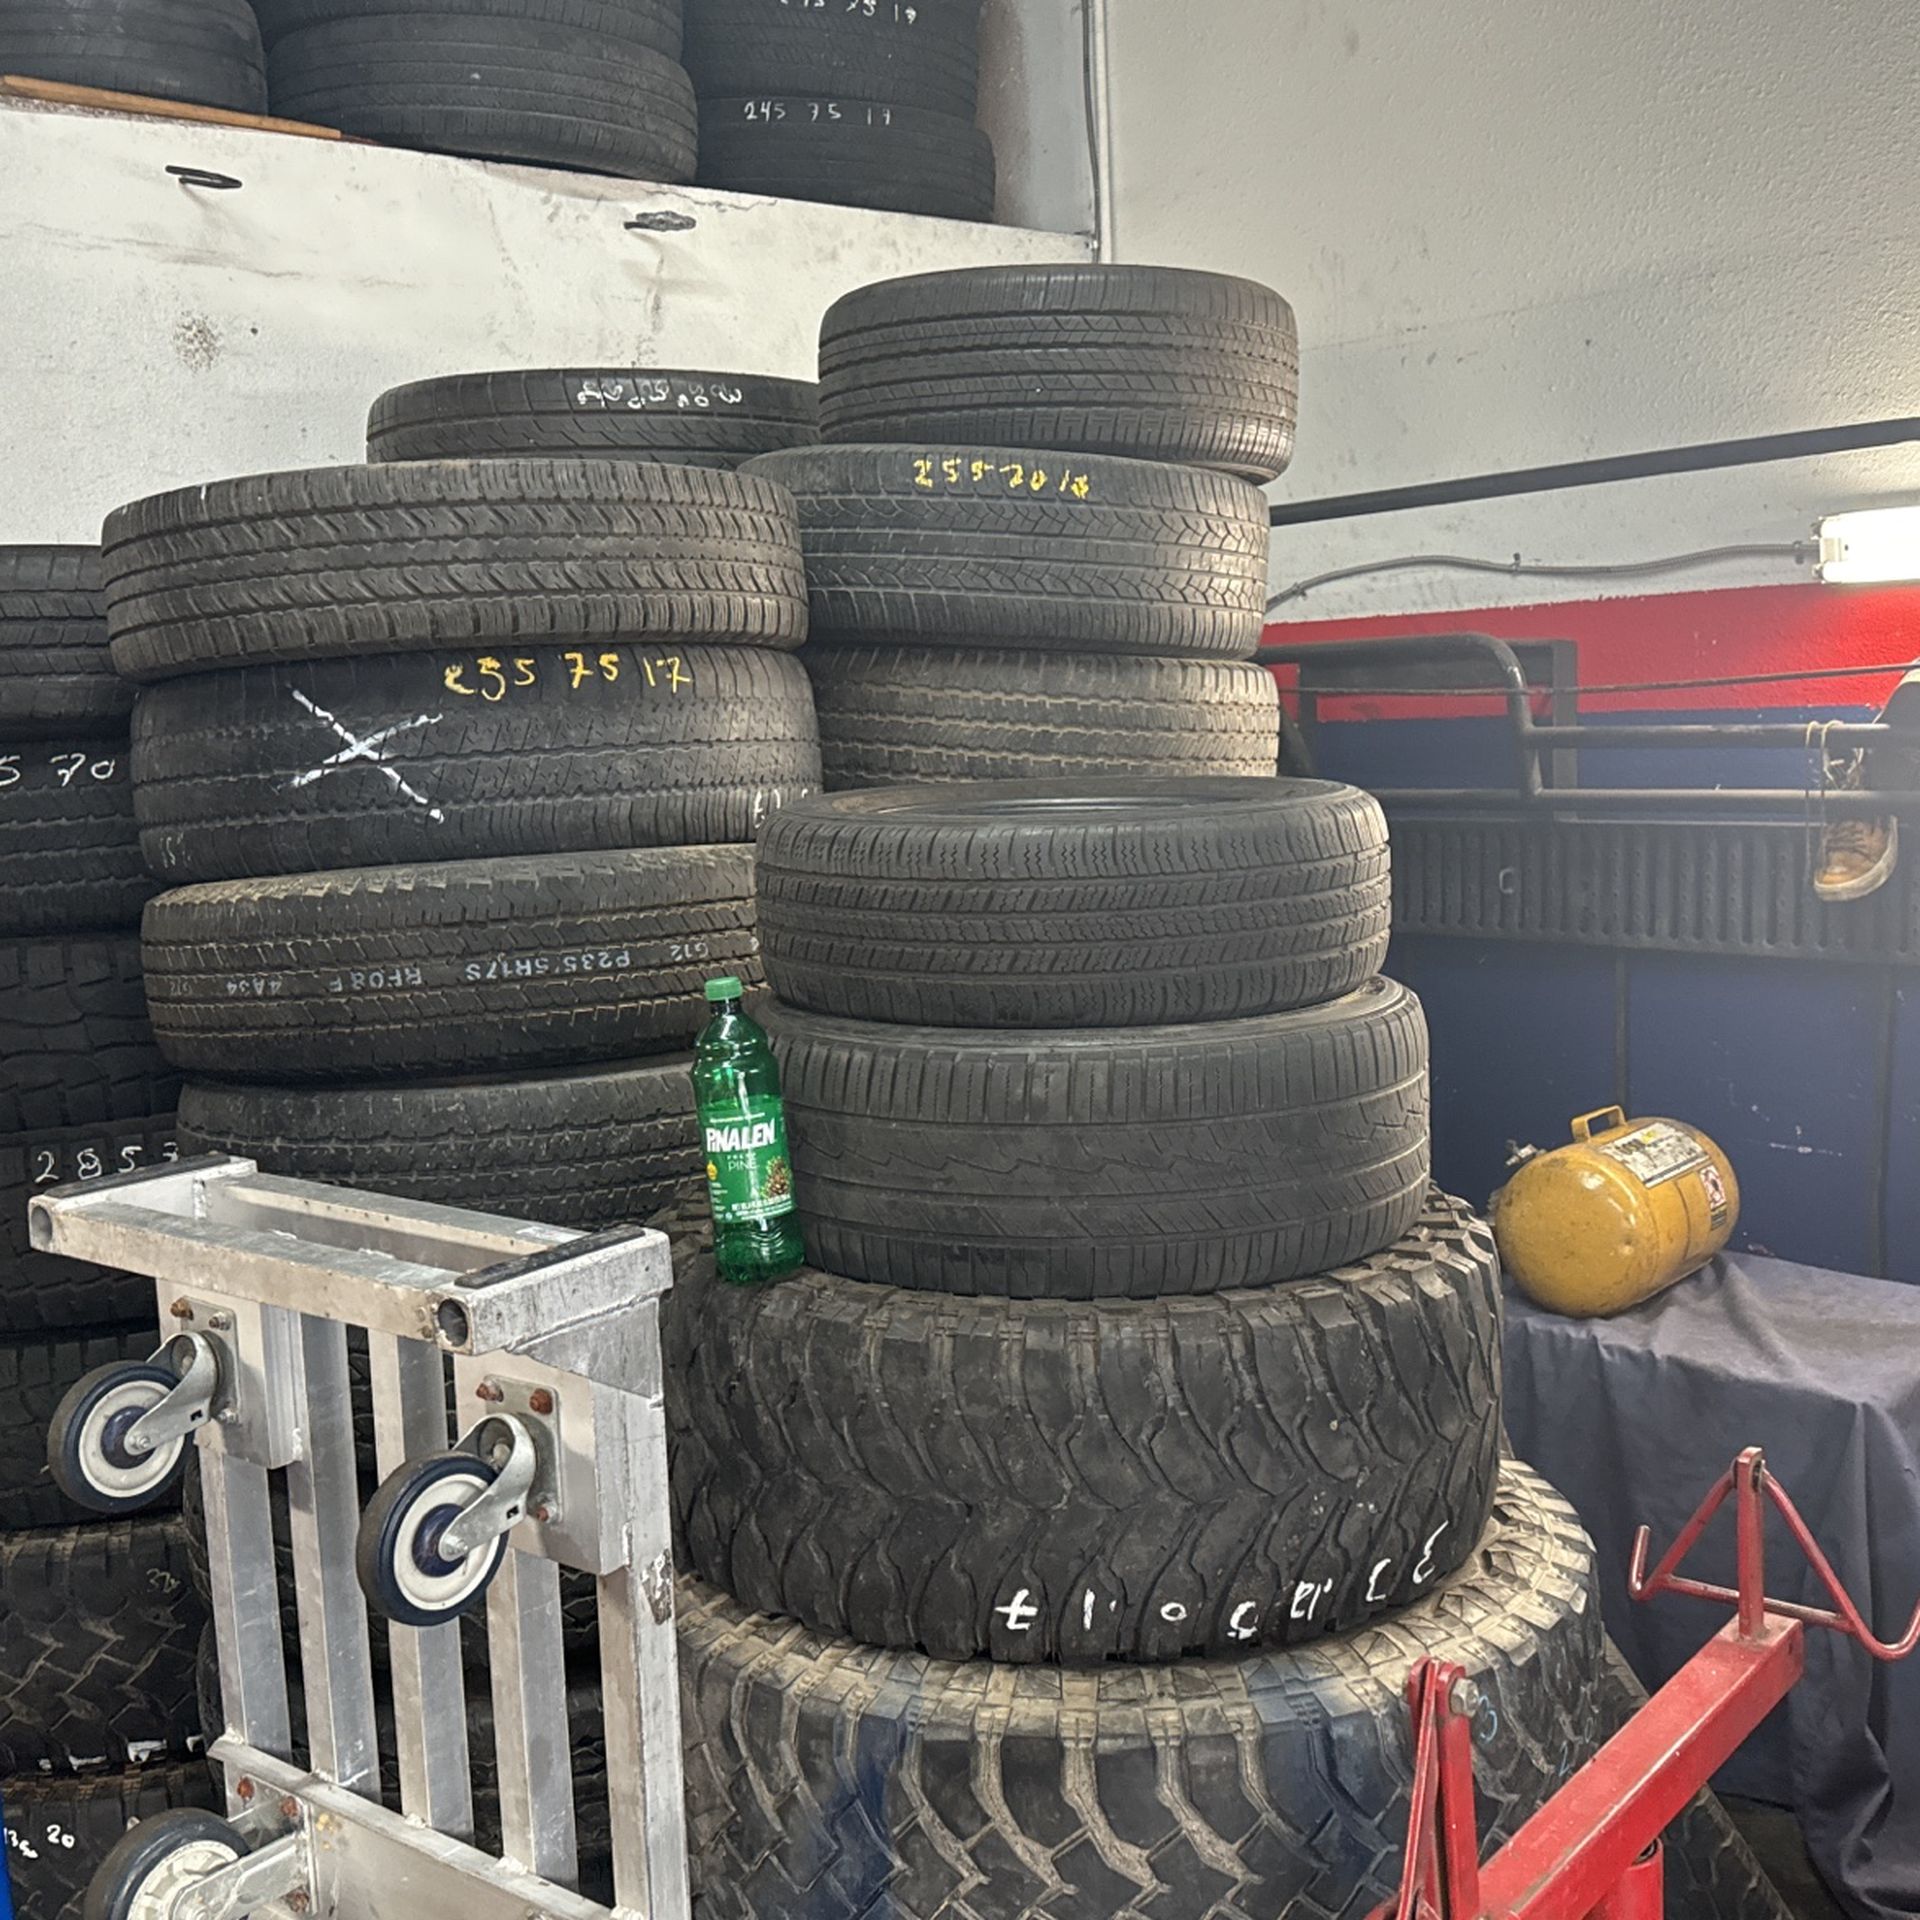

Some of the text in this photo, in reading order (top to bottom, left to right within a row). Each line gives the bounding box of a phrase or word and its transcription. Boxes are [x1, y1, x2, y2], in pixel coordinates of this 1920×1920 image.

[744, 101, 786, 121] 245
[559, 652, 620, 690] 75
[642, 655, 693, 693] 17
[50, 752, 116, 787] 70
[46, 1824, 76, 1849] 20
